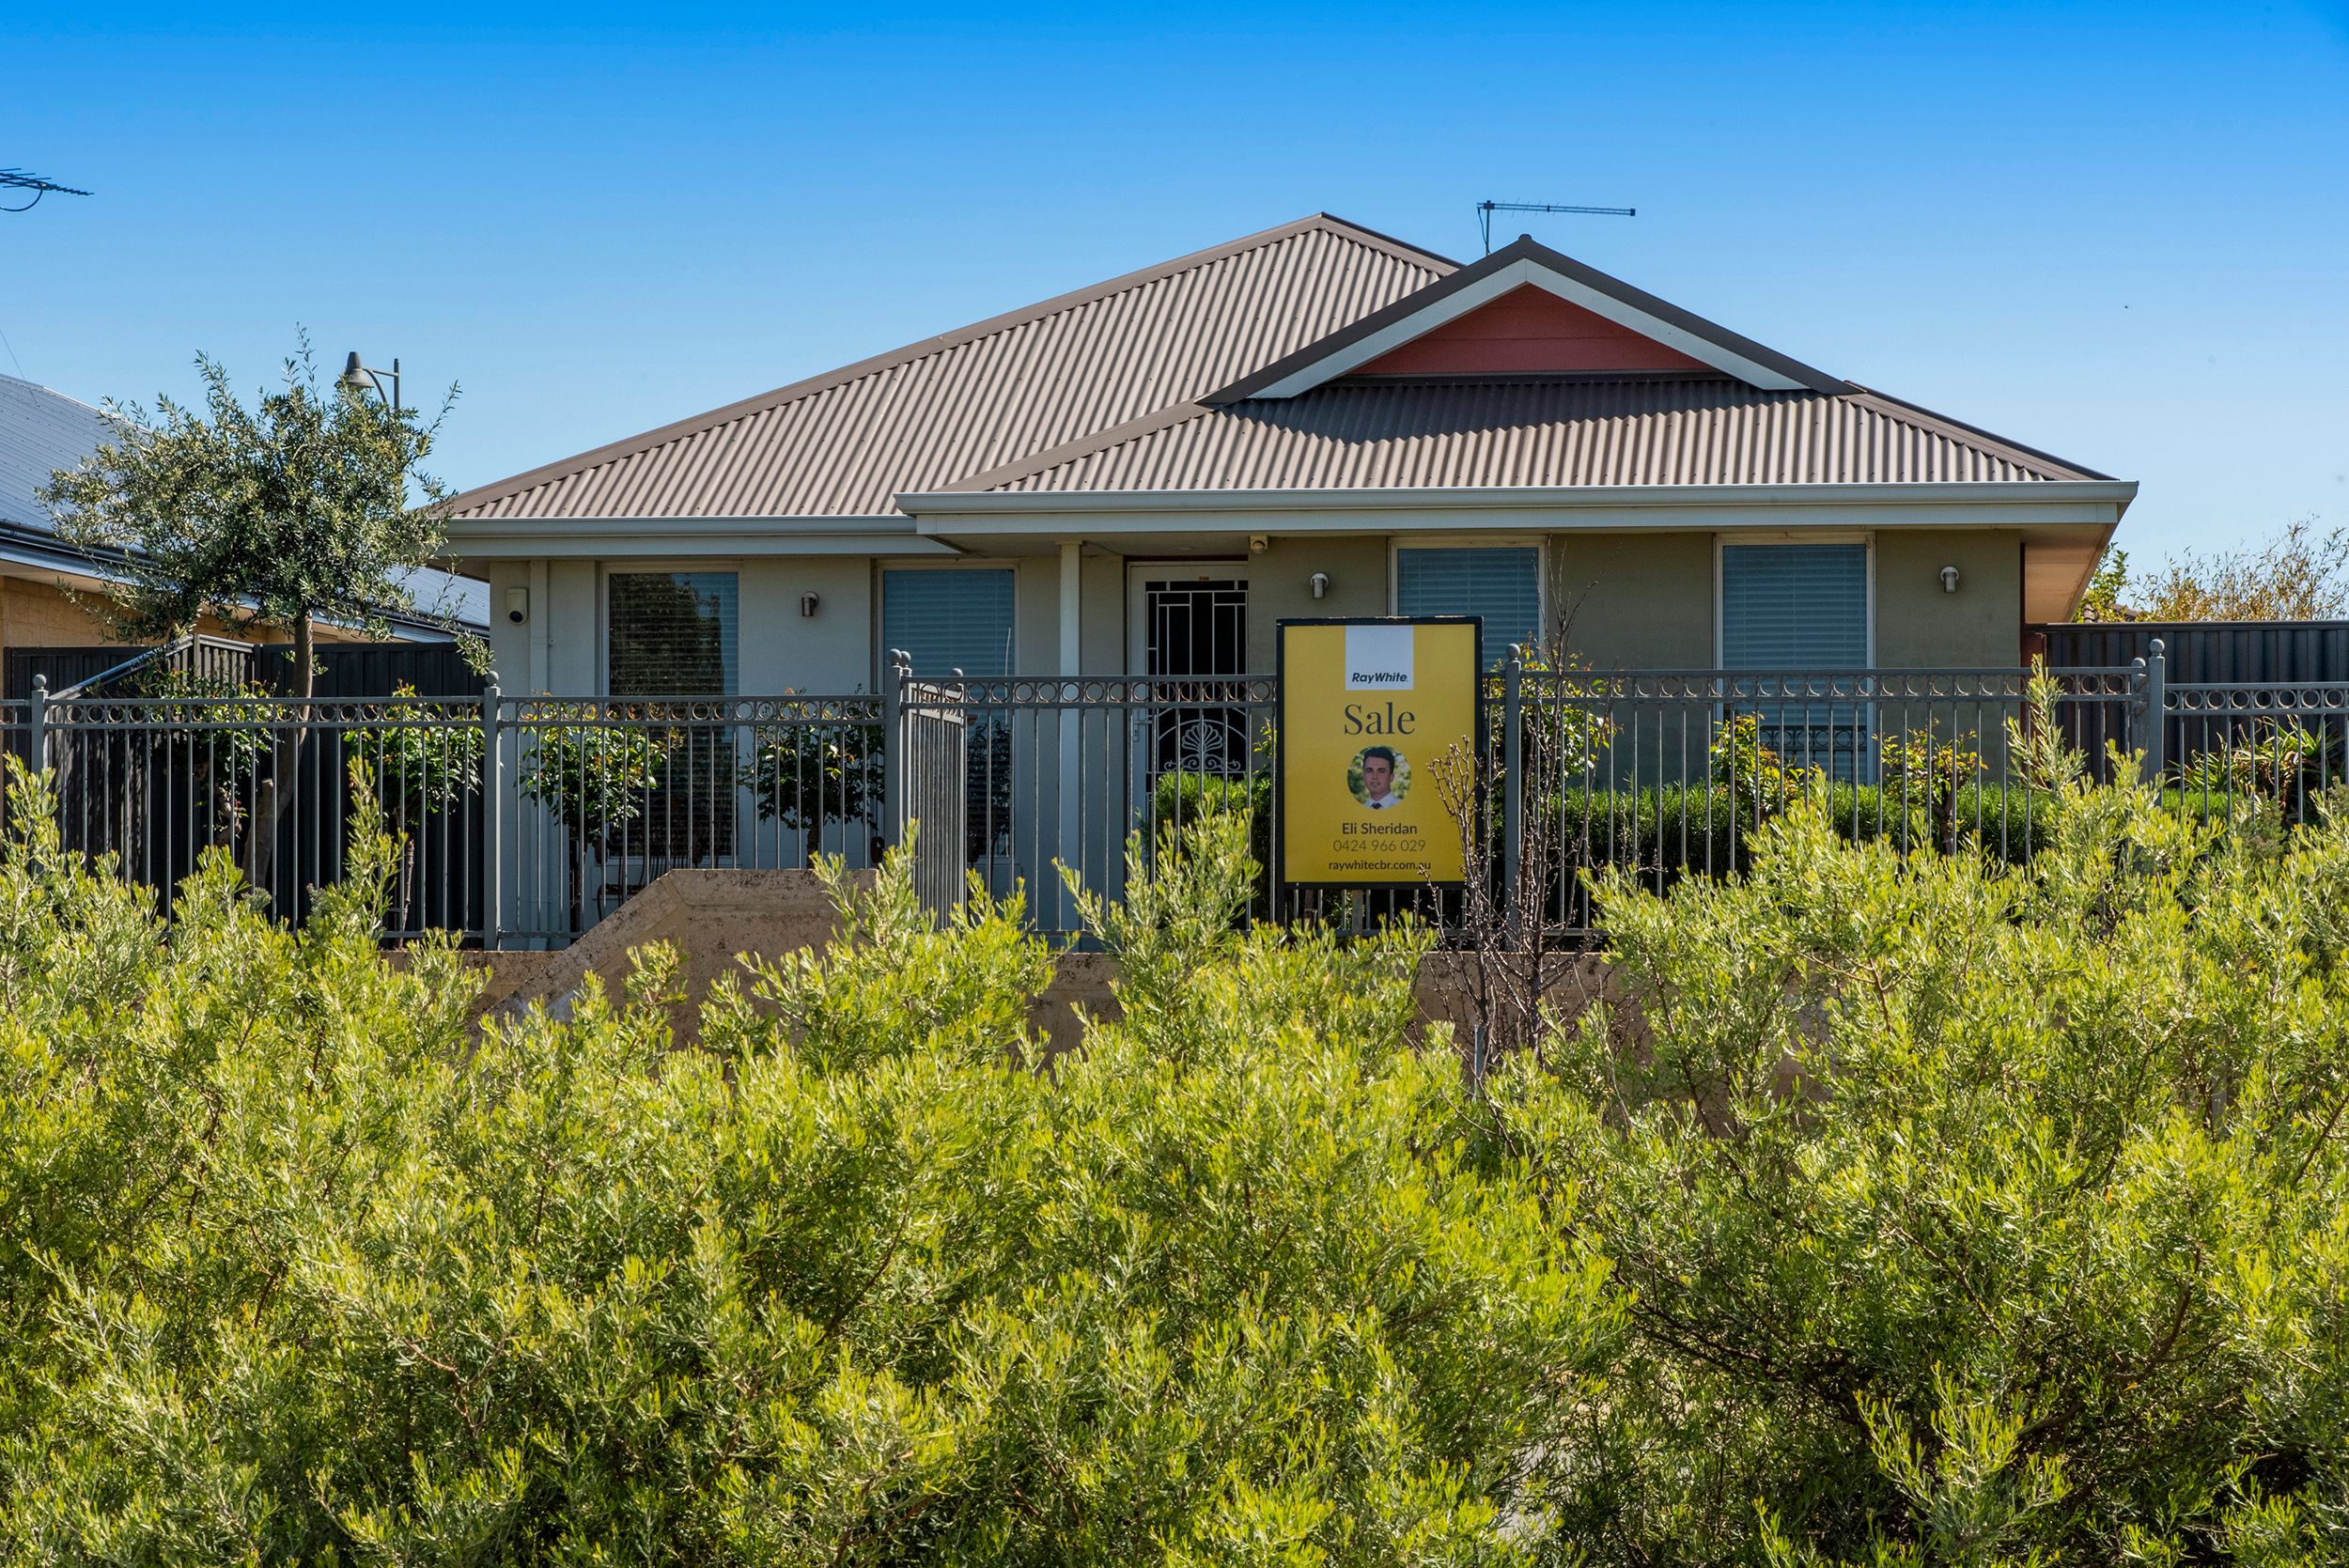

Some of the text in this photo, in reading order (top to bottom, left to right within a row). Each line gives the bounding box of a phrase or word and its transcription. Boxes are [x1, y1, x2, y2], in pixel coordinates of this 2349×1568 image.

[1344, 702, 1416, 736] Sale
[1342, 822, 1418, 834] Eli Sheridan
[1332, 839, 1426, 852] 0424 966 029
[1329, 860, 1431, 872] raywhitecbr.com.au
